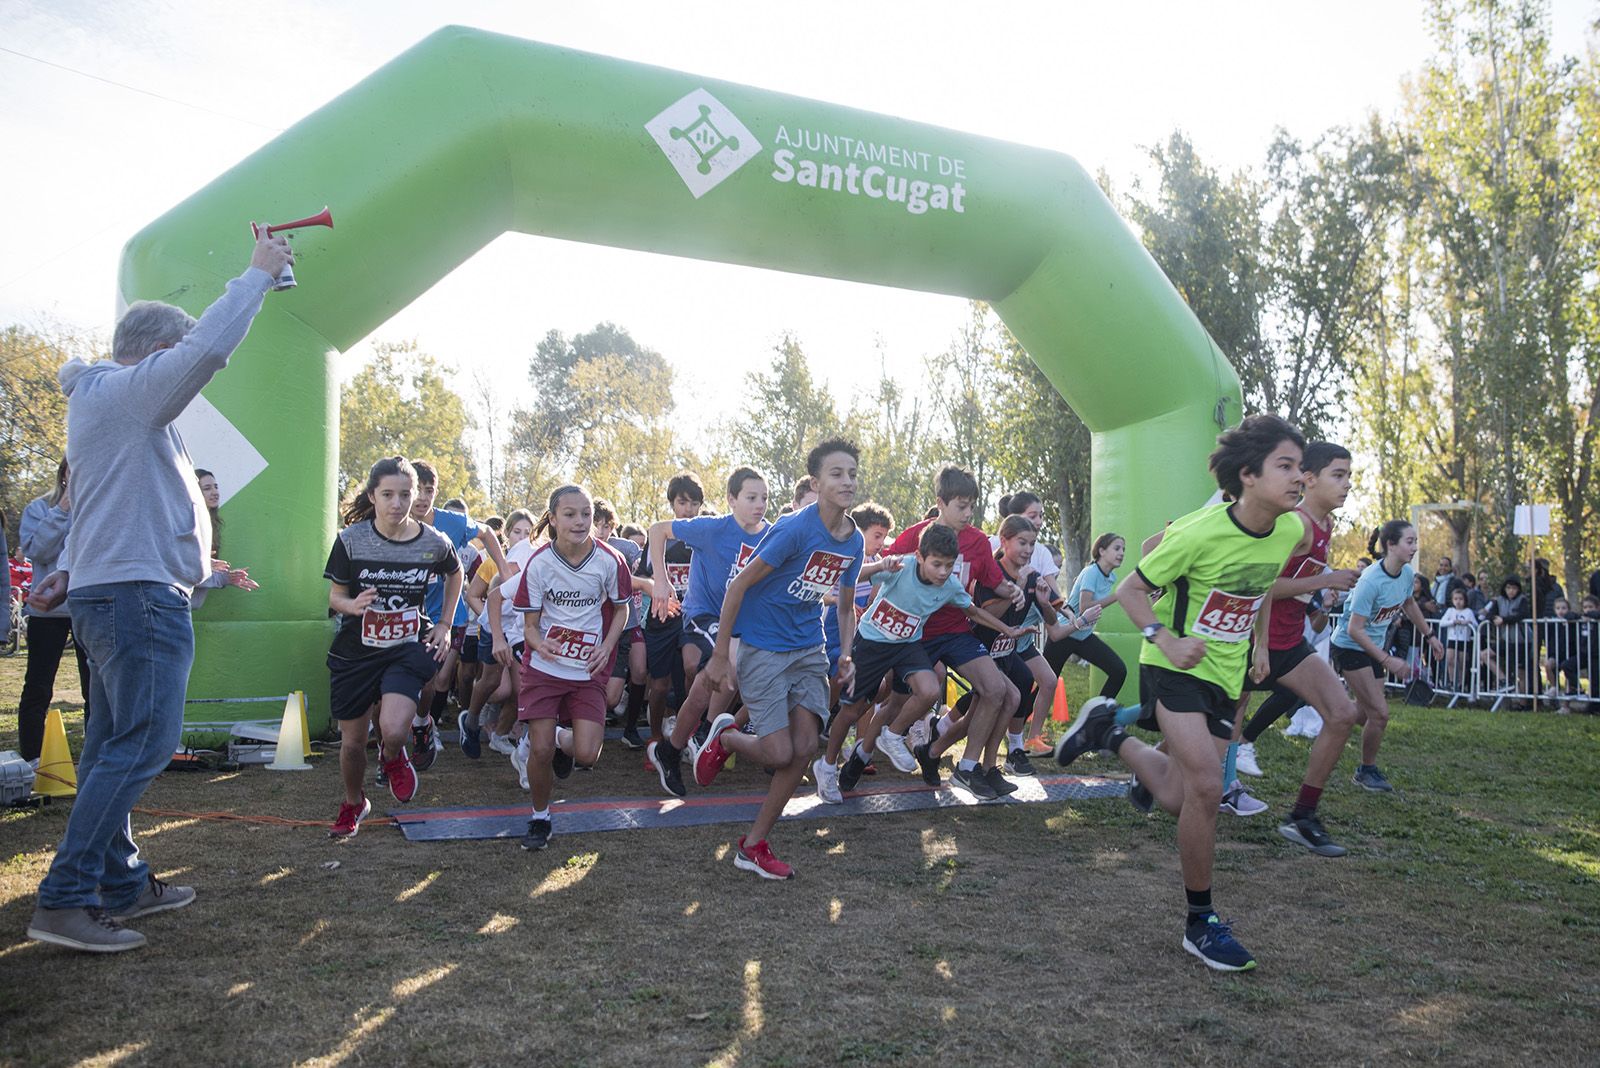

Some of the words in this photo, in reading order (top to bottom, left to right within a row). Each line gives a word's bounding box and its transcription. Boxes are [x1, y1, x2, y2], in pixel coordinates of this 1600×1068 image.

[775, 125, 931, 172] AJUNTAMENT
[938, 155, 967, 180] DE
[771, 149, 967, 215] SantCugat
[548, 588, 580, 600] Agora
[367, 622, 415, 640] 1451
[874, 611, 913, 638] 1288
